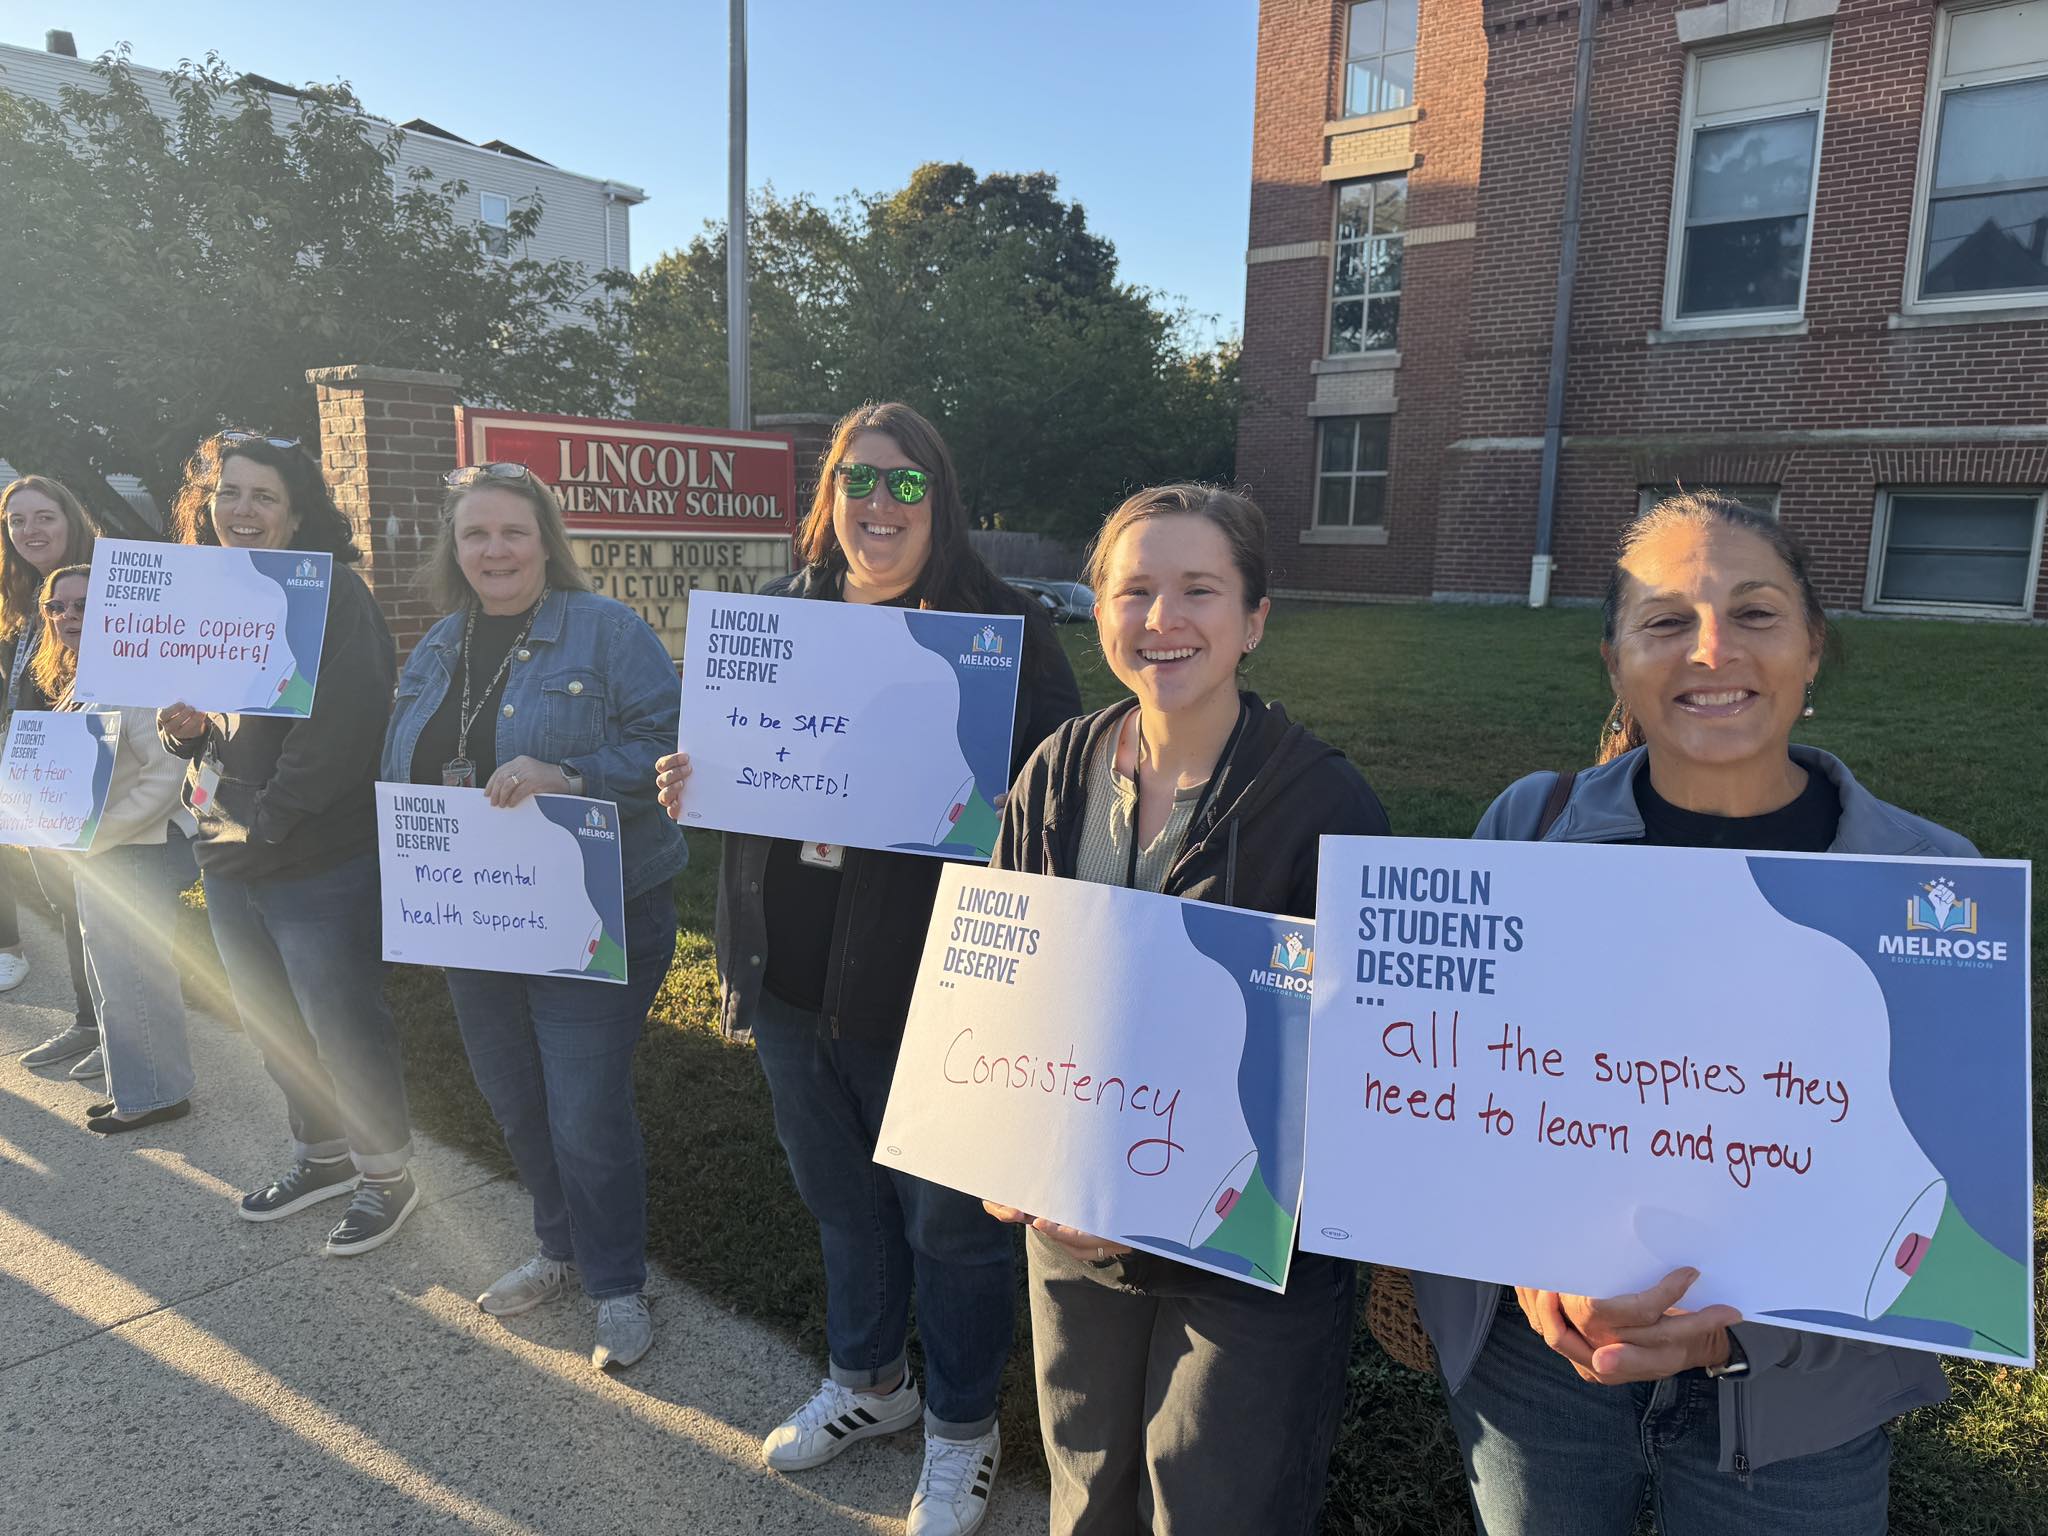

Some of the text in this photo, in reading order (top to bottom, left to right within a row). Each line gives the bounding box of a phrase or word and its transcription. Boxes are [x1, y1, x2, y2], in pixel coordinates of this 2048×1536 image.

[557, 439, 736, 490] LINCOLN
[551, 485, 784, 519] MENTARY SCHOOL
[111, 550, 163, 569] LINCOLN
[591, 543, 743, 567] OPEN HOUSE
[108, 567, 173, 586] STUDENTS
[286, 578, 324, 588] MELROSE
[592, 574, 758, 598] PICTURE DAY
[106, 584, 162, 602] DESERVE
[104, 612, 276, 644] reliable copiers
[711, 608, 779, 634] LINCOLN
[113, 638, 270, 671] and computers!
[708, 633, 794, 661] STUDENTS
[706, 658, 778, 684] DESERVE
[959, 654, 1013, 668] MELROSE
[17, 719, 43, 732] LINCOLN
[726, 707, 850, 738] to be SAFE
[14, 733, 46, 746] STUDENTS
[11, 747, 38, 759] DESERVE
[44, 759, 72, 783] fear
[736, 767, 849, 798] SUPPORTED!
[394, 795, 445, 815] LINCOLN
[395, 815, 459, 834] STUDENTS
[578, 827, 615, 840] MELROSE
[396, 833, 451, 852] DESERVE
[474, 864, 537, 887] mental
[1360, 865, 1492, 907] LINCOLN
[400, 898, 548, 932] health supports.
[957, 886, 1030, 921] LINCOLN
[950, 917, 1041, 956] STUDENTS
[1358, 906, 1524, 952] STUDENTS
[1878, 935, 2008, 961] MELROSE
[943, 946, 1020, 986] DESERVE
[1356, 948, 1496, 995] DESERVE
[1891, 956, 1994, 969] EDUCATORS UNION
[1248, 968, 1314, 995] MELROS
[1381, 1010, 1850, 1123] all the supplies they
[943, 1027, 1185, 1176] Consistency
[1363, 1071, 1813, 1188] need to learn and grow
